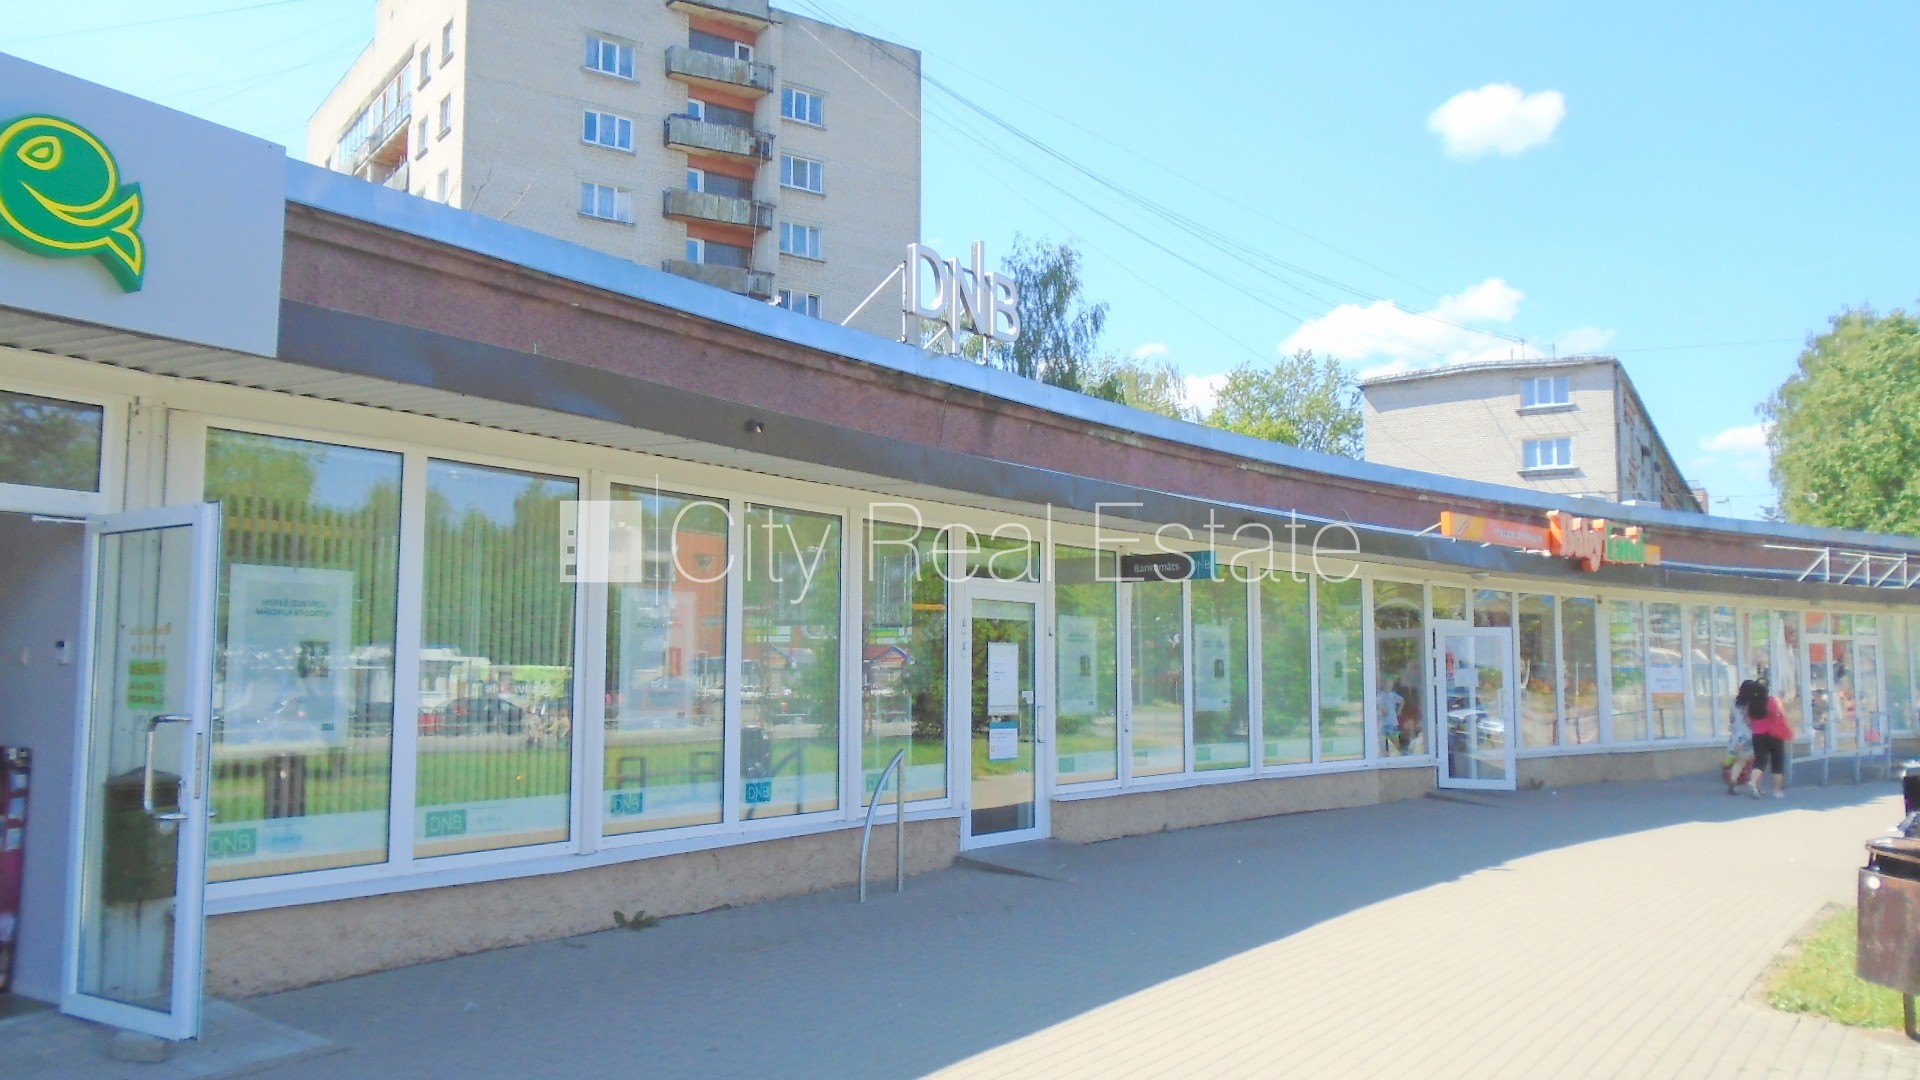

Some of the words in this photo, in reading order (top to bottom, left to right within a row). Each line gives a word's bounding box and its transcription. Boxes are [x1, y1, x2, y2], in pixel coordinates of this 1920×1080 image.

[906, 240, 1020, 355] DNB
[612, 792, 641, 816] DNB
[748, 781, 771, 804] DNB
[429, 810, 463, 837] DNB
[210, 828, 252, 859] DNB
